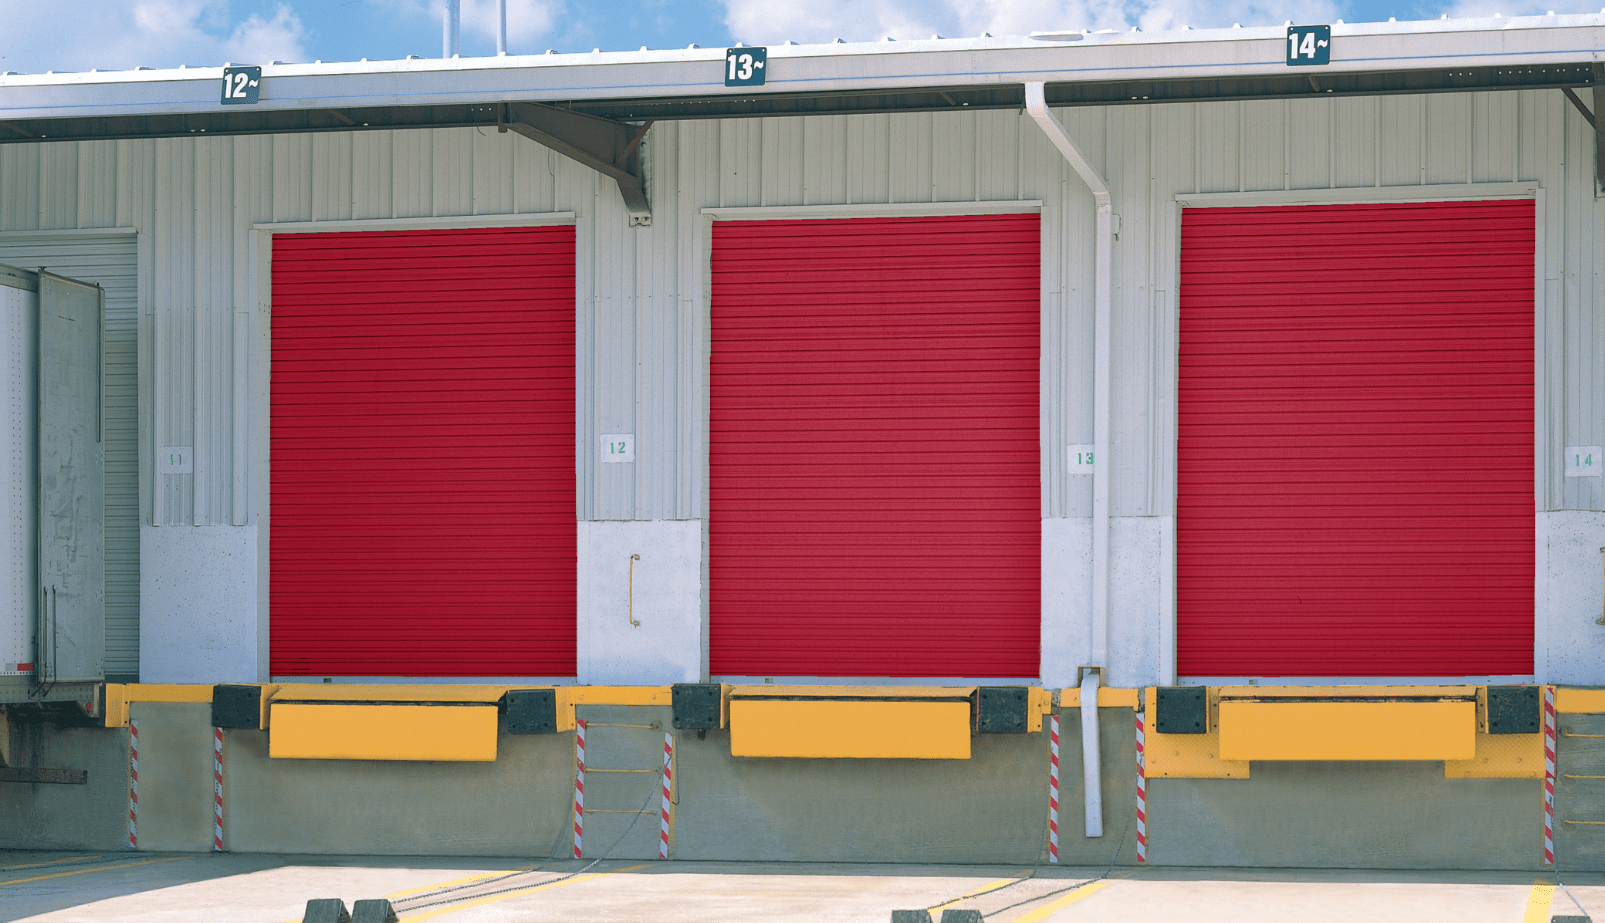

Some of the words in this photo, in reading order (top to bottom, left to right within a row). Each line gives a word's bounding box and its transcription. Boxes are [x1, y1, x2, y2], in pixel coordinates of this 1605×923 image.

[611, 442, 626, 453] 12
[1078, 452, 1094, 465] 13
[1575, 453, 1592, 466] 14
